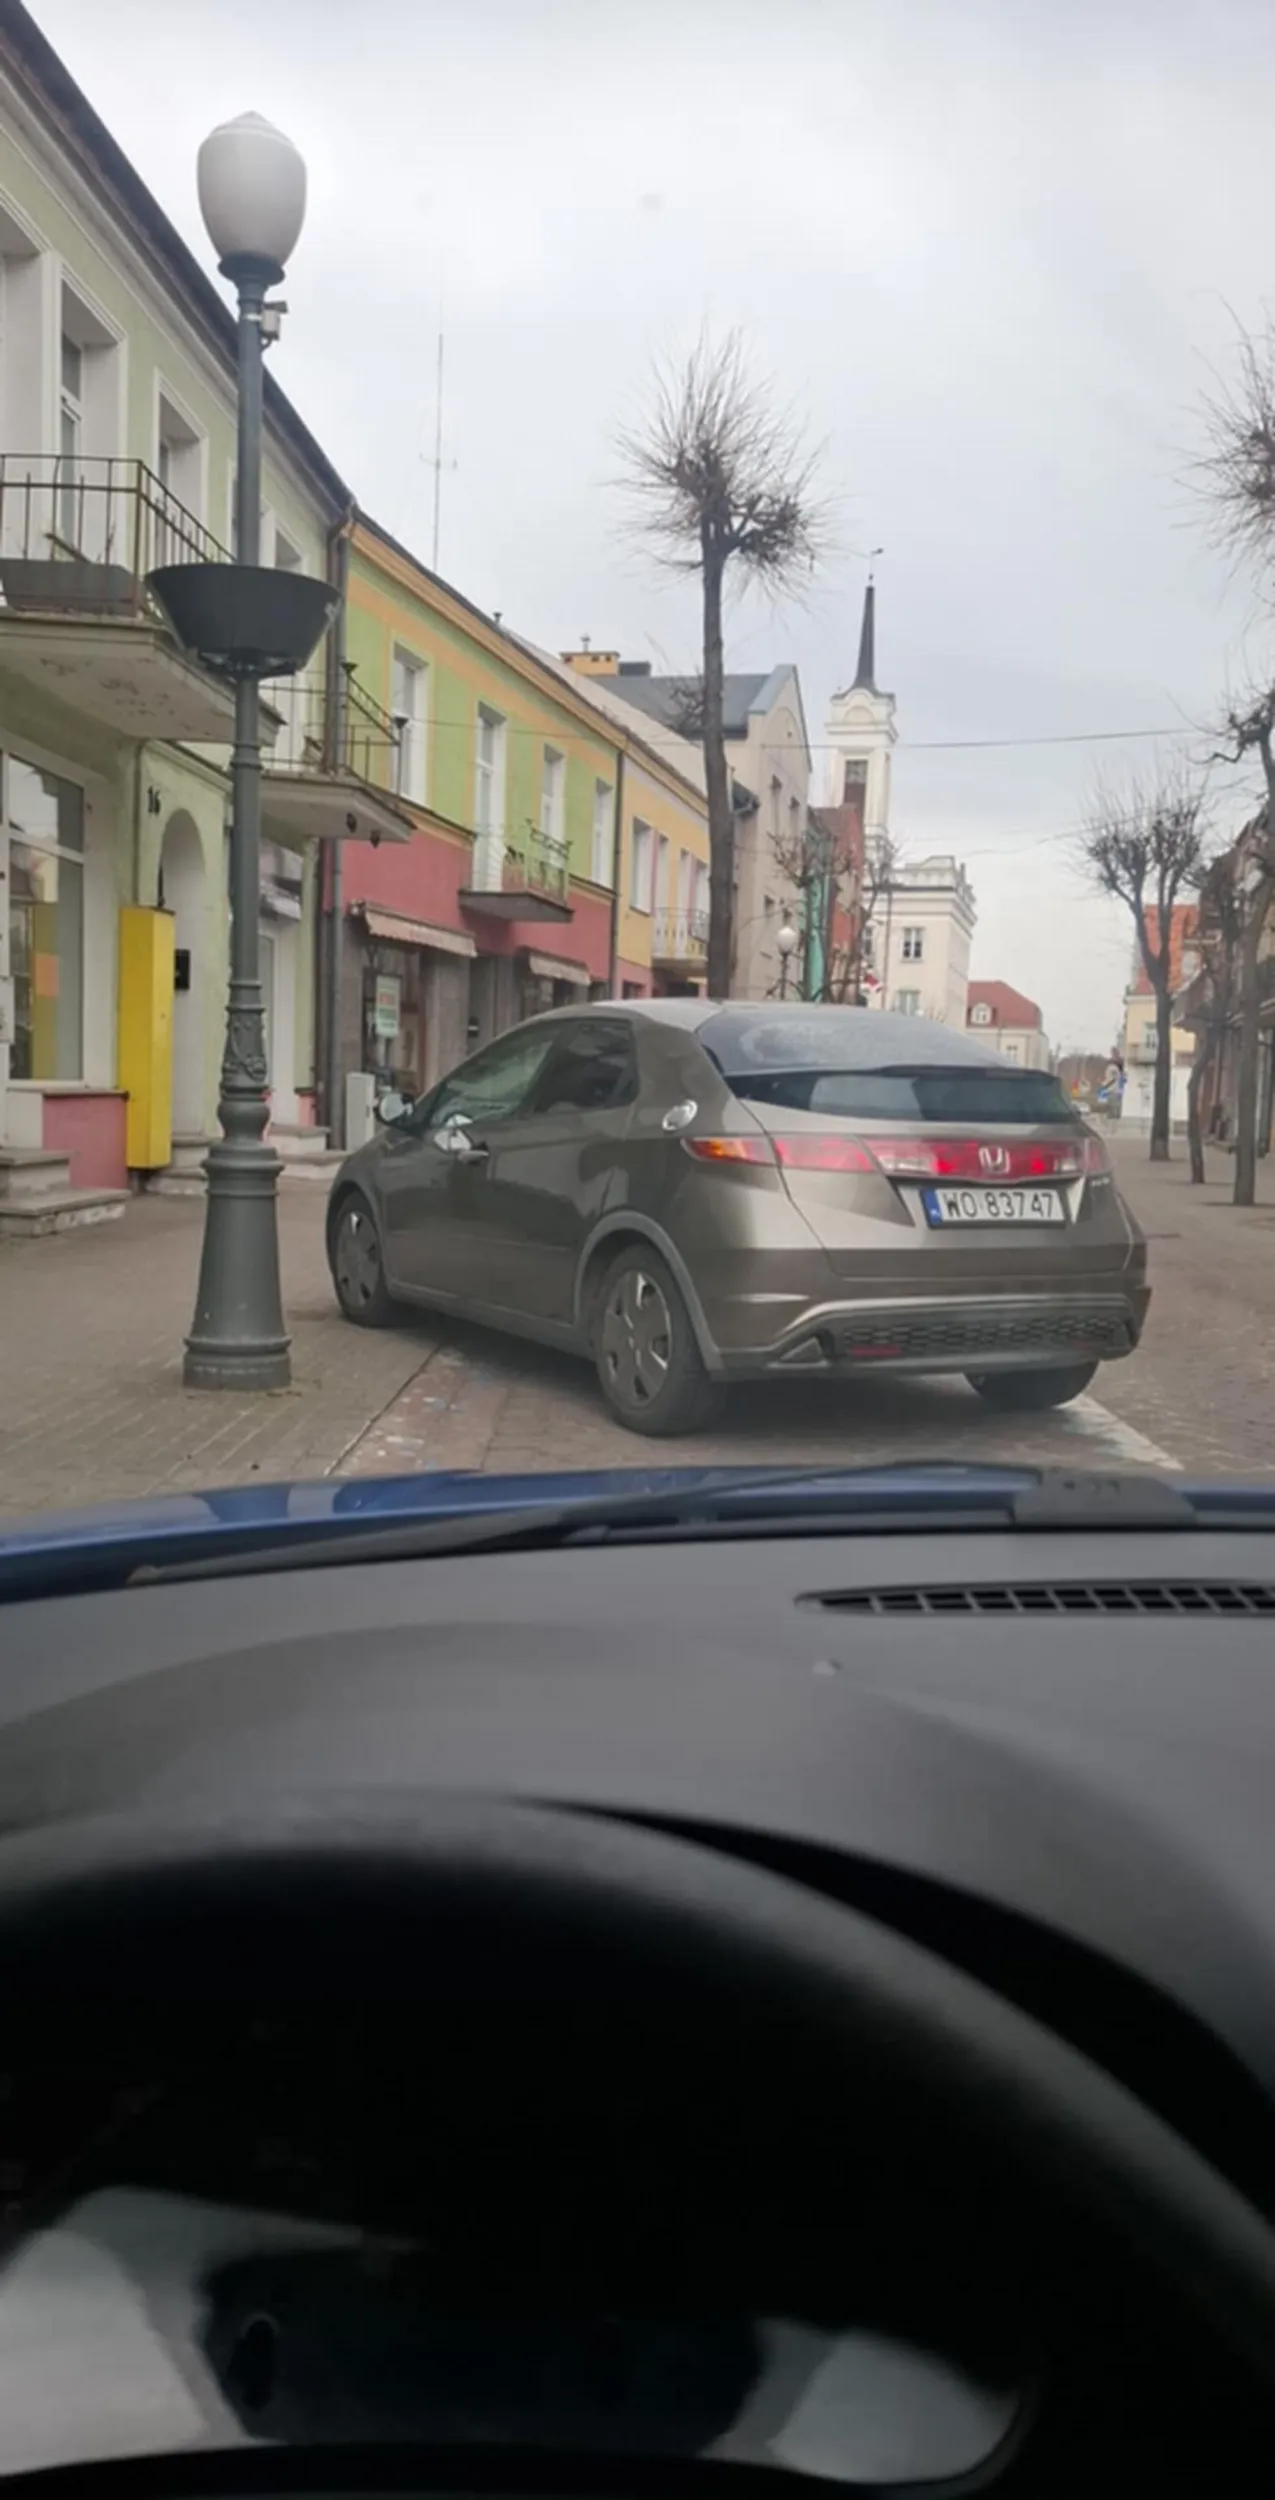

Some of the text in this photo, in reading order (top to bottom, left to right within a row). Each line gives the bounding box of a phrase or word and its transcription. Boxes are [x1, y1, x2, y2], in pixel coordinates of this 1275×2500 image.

[147, 785, 161, 815] 16
[942, 1191, 1053, 1218] WO 83747
